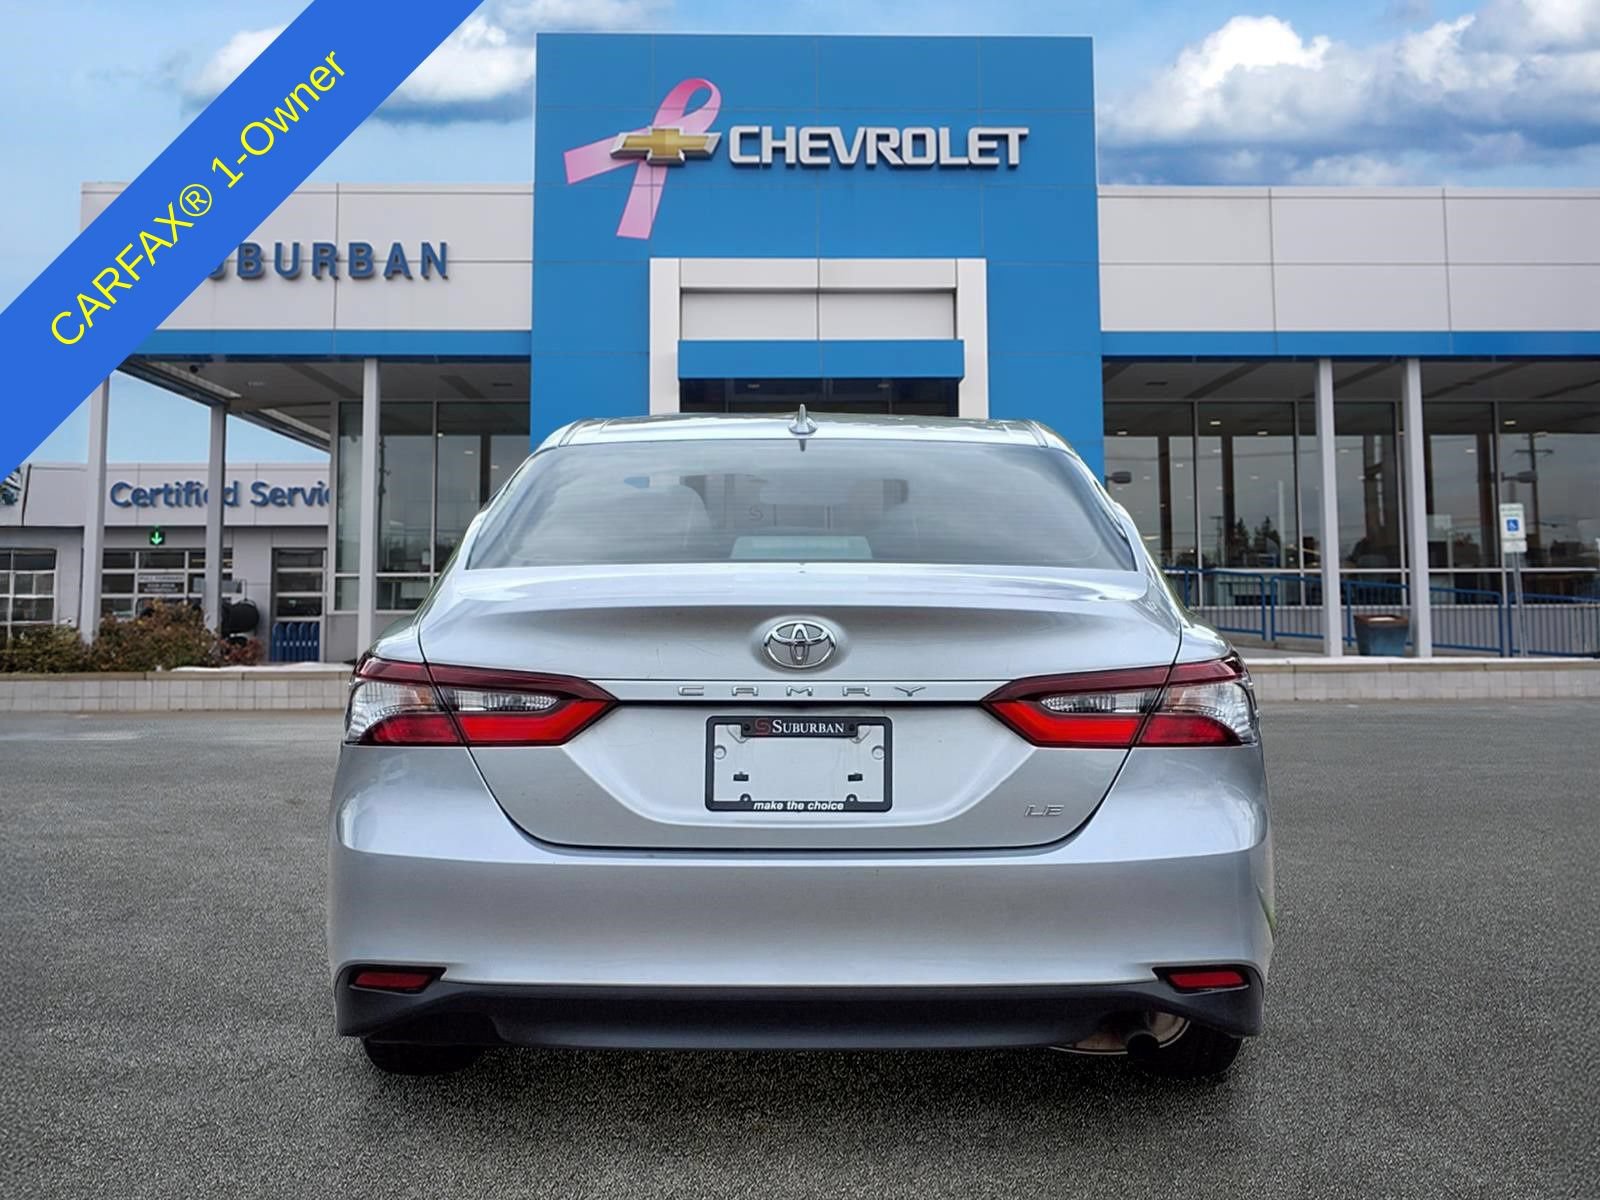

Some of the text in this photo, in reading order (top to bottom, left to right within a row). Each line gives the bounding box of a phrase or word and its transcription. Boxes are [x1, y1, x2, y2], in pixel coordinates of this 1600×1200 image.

[729, 125, 1029, 167] CHEVROLET
[110, 481, 240, 507] Certifid
[678, 685, 926, 697] CAMRY
[753, 801, 844, 810] make the choice
[1024, 804, 1065, 817] LE
